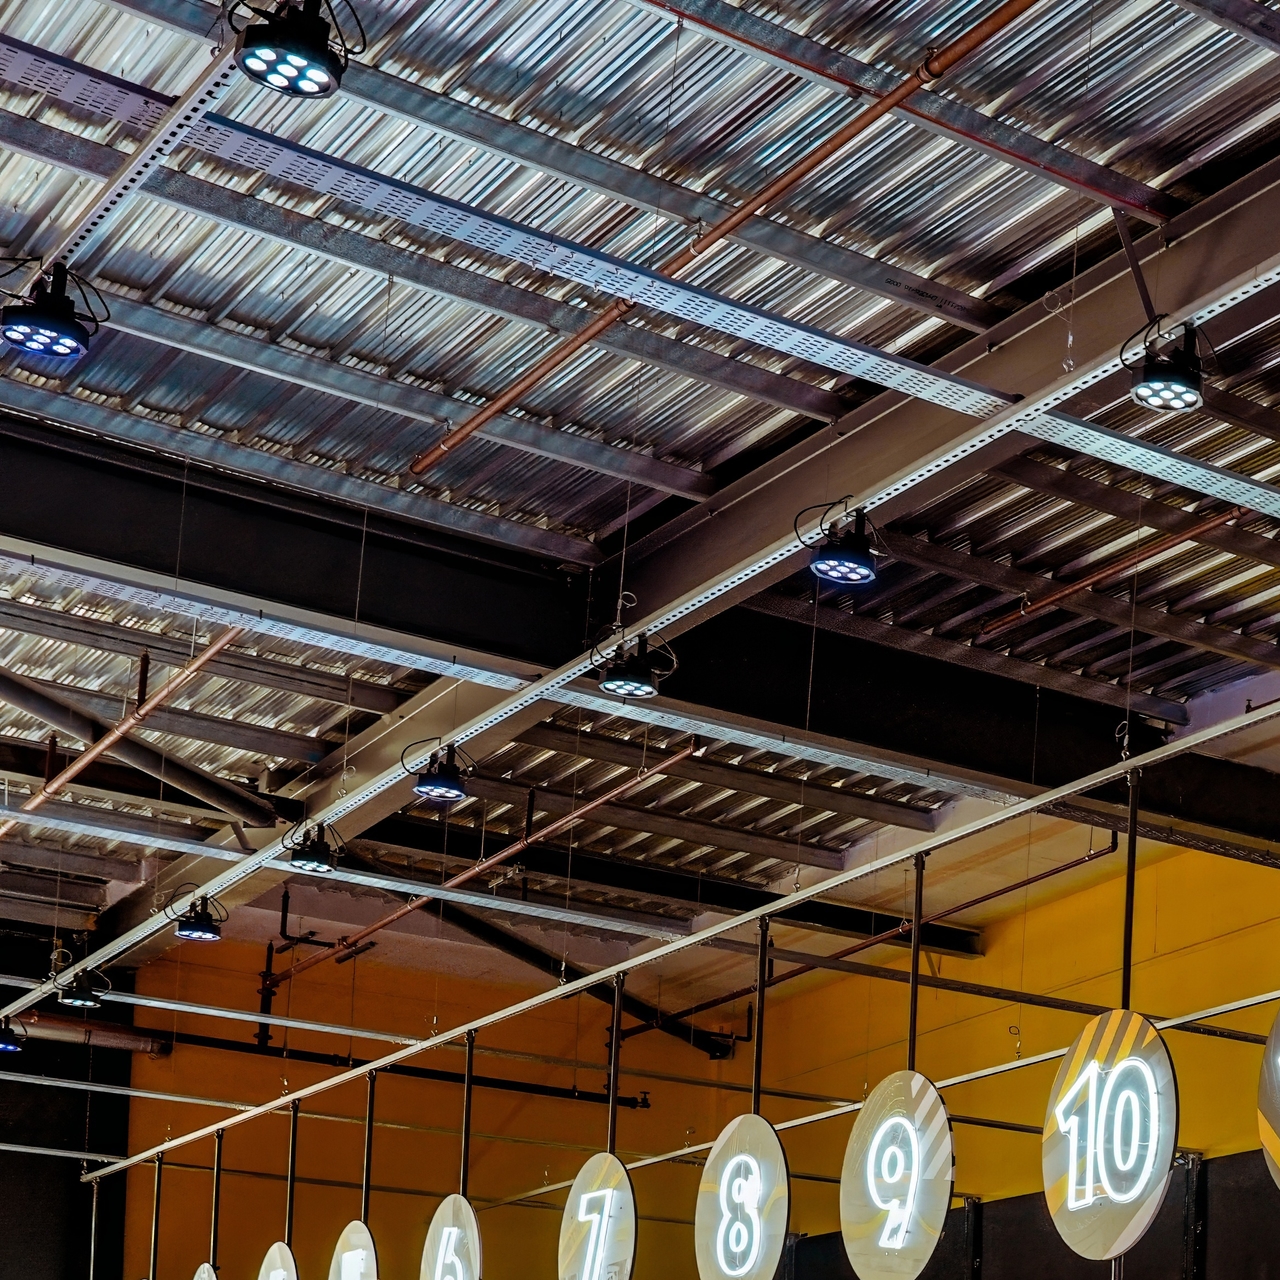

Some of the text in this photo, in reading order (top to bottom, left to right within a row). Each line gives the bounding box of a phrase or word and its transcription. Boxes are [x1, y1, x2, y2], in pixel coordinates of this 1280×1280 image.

[867, 1115, 921, 1250] 9
[1055, 1057, 1160, 1210] 10
[717, 1153, 762, 1277] 8
